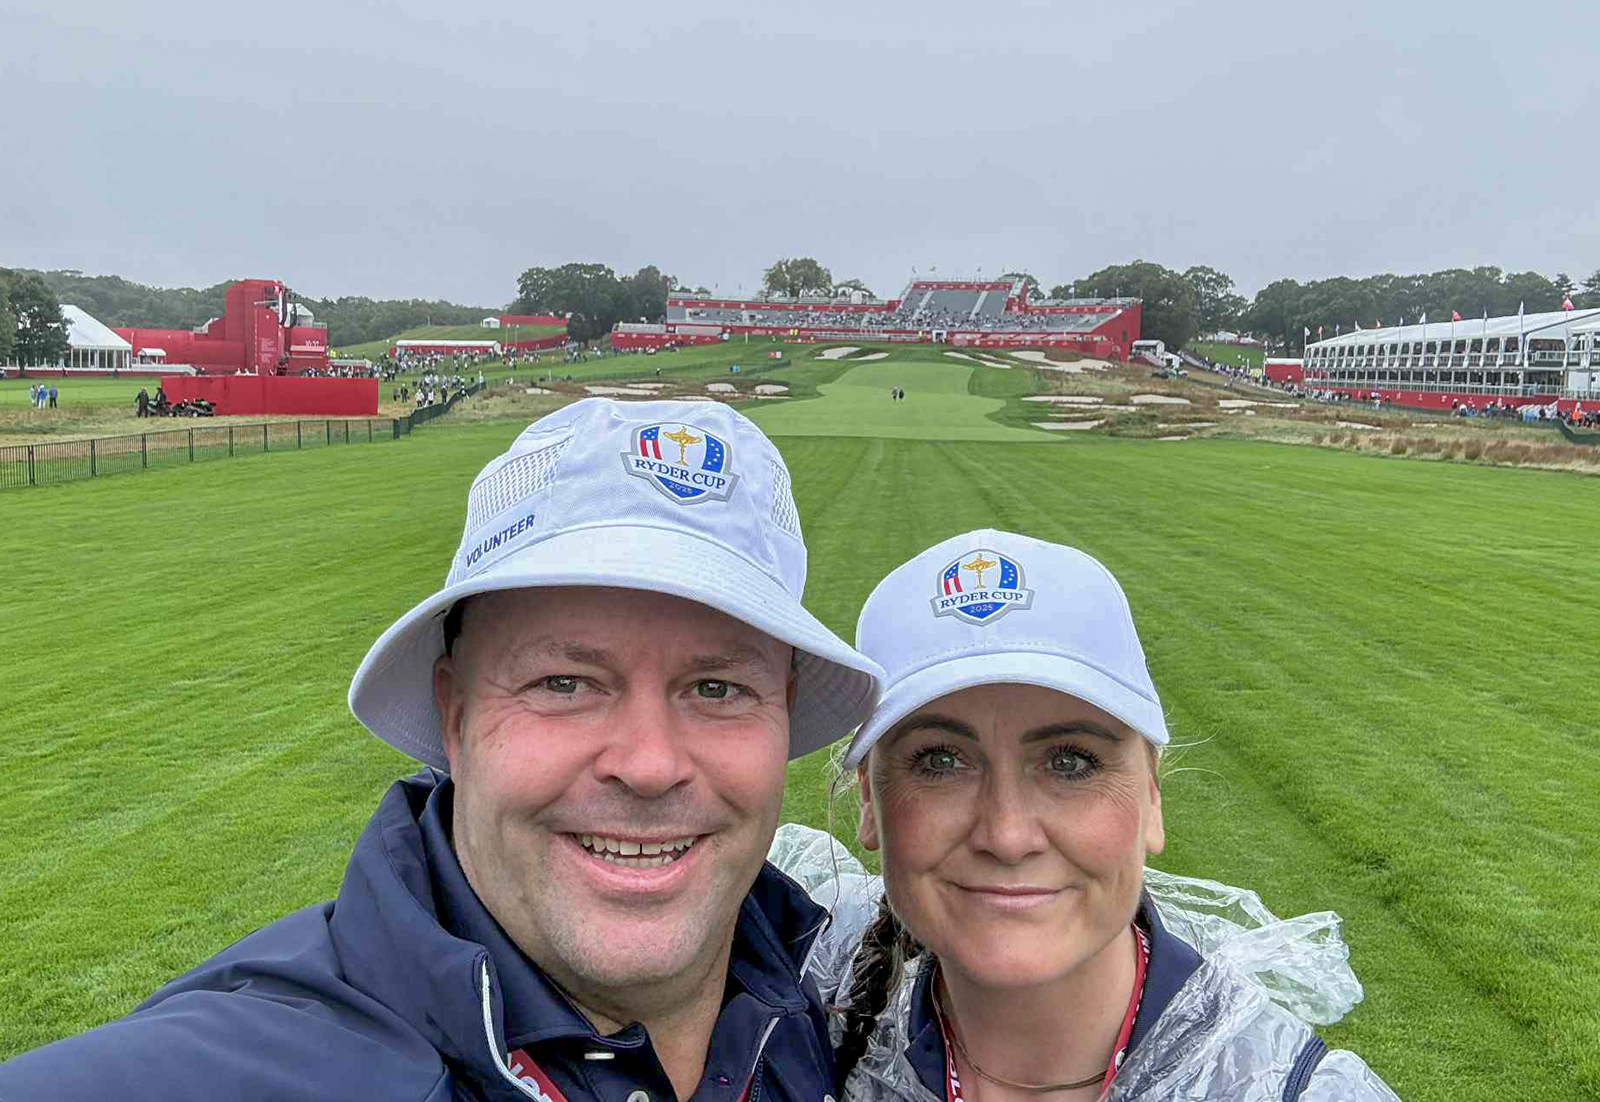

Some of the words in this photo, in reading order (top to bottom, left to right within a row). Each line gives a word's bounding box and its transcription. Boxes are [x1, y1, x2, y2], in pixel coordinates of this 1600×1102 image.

[635, 458, 690, 482] RYDER
[692, 472, 726, 489] CUP
[466, 514, 535, 568] VOLUNTEER
[940, 591, 988, 609] RYDER
[991, 591, 1023, 601] CUP
[969, 605, 994, 613] 2025
